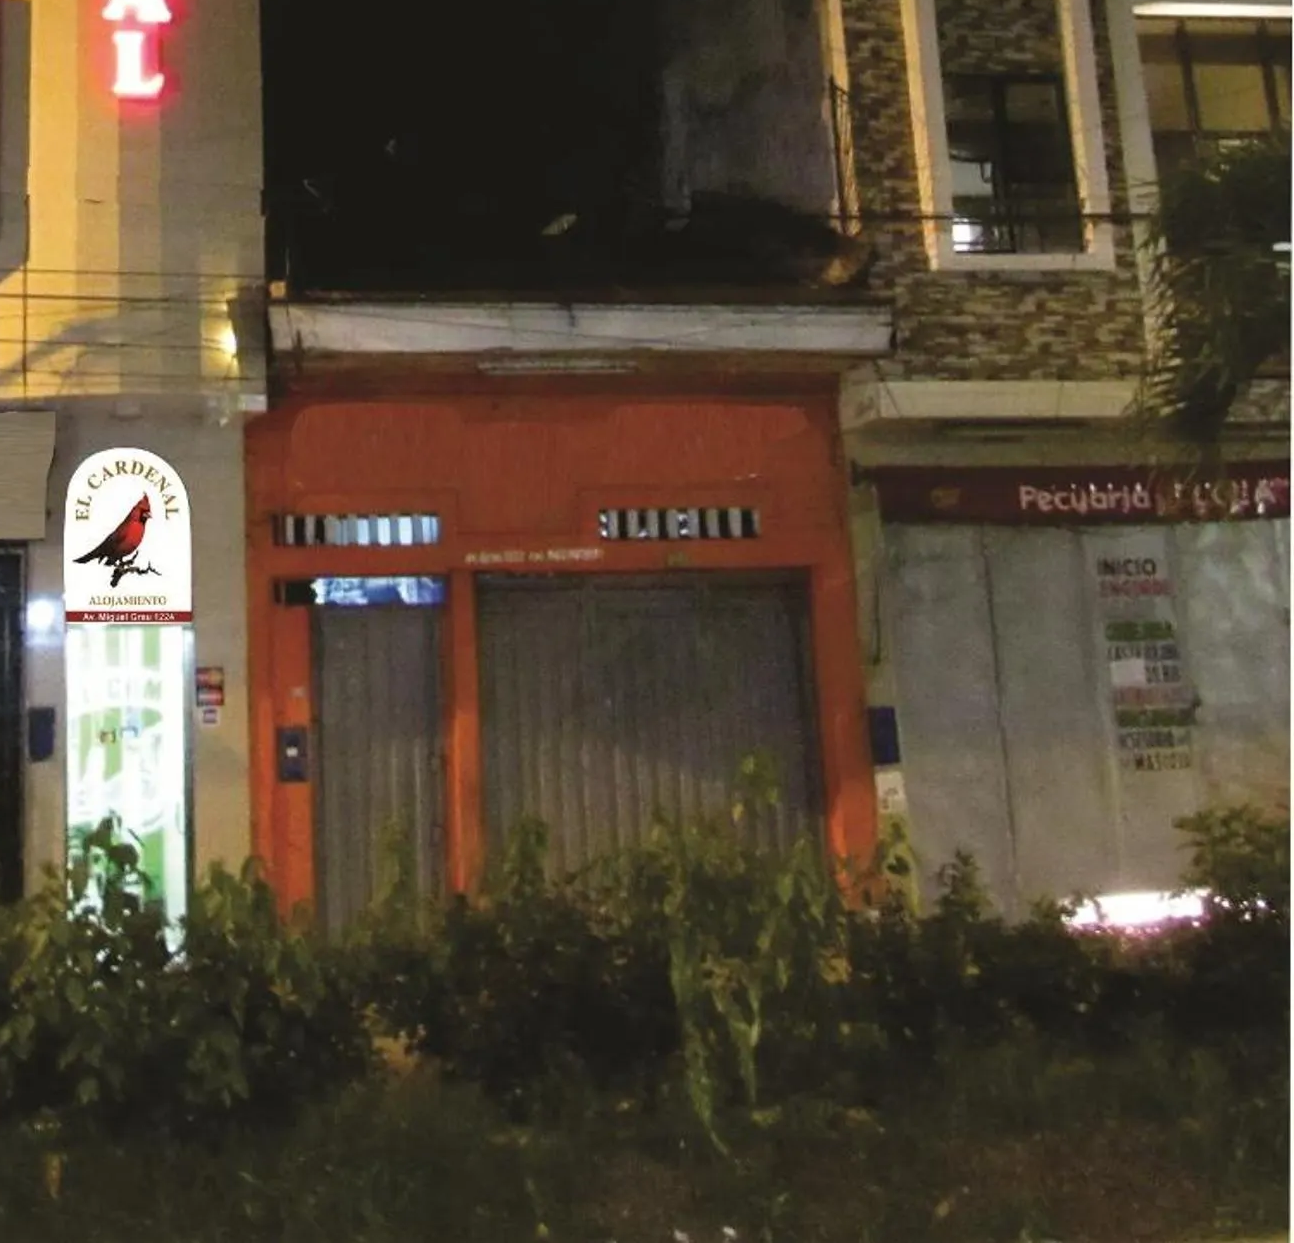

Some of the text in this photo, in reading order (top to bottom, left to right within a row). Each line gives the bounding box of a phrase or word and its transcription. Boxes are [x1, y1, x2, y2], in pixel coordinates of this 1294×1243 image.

[75, 460, 179, 521] EL CARDENAL
[89, 595, 167, 607] ALOJAMIENTO
[98, 612, 129, 623] Miguel
